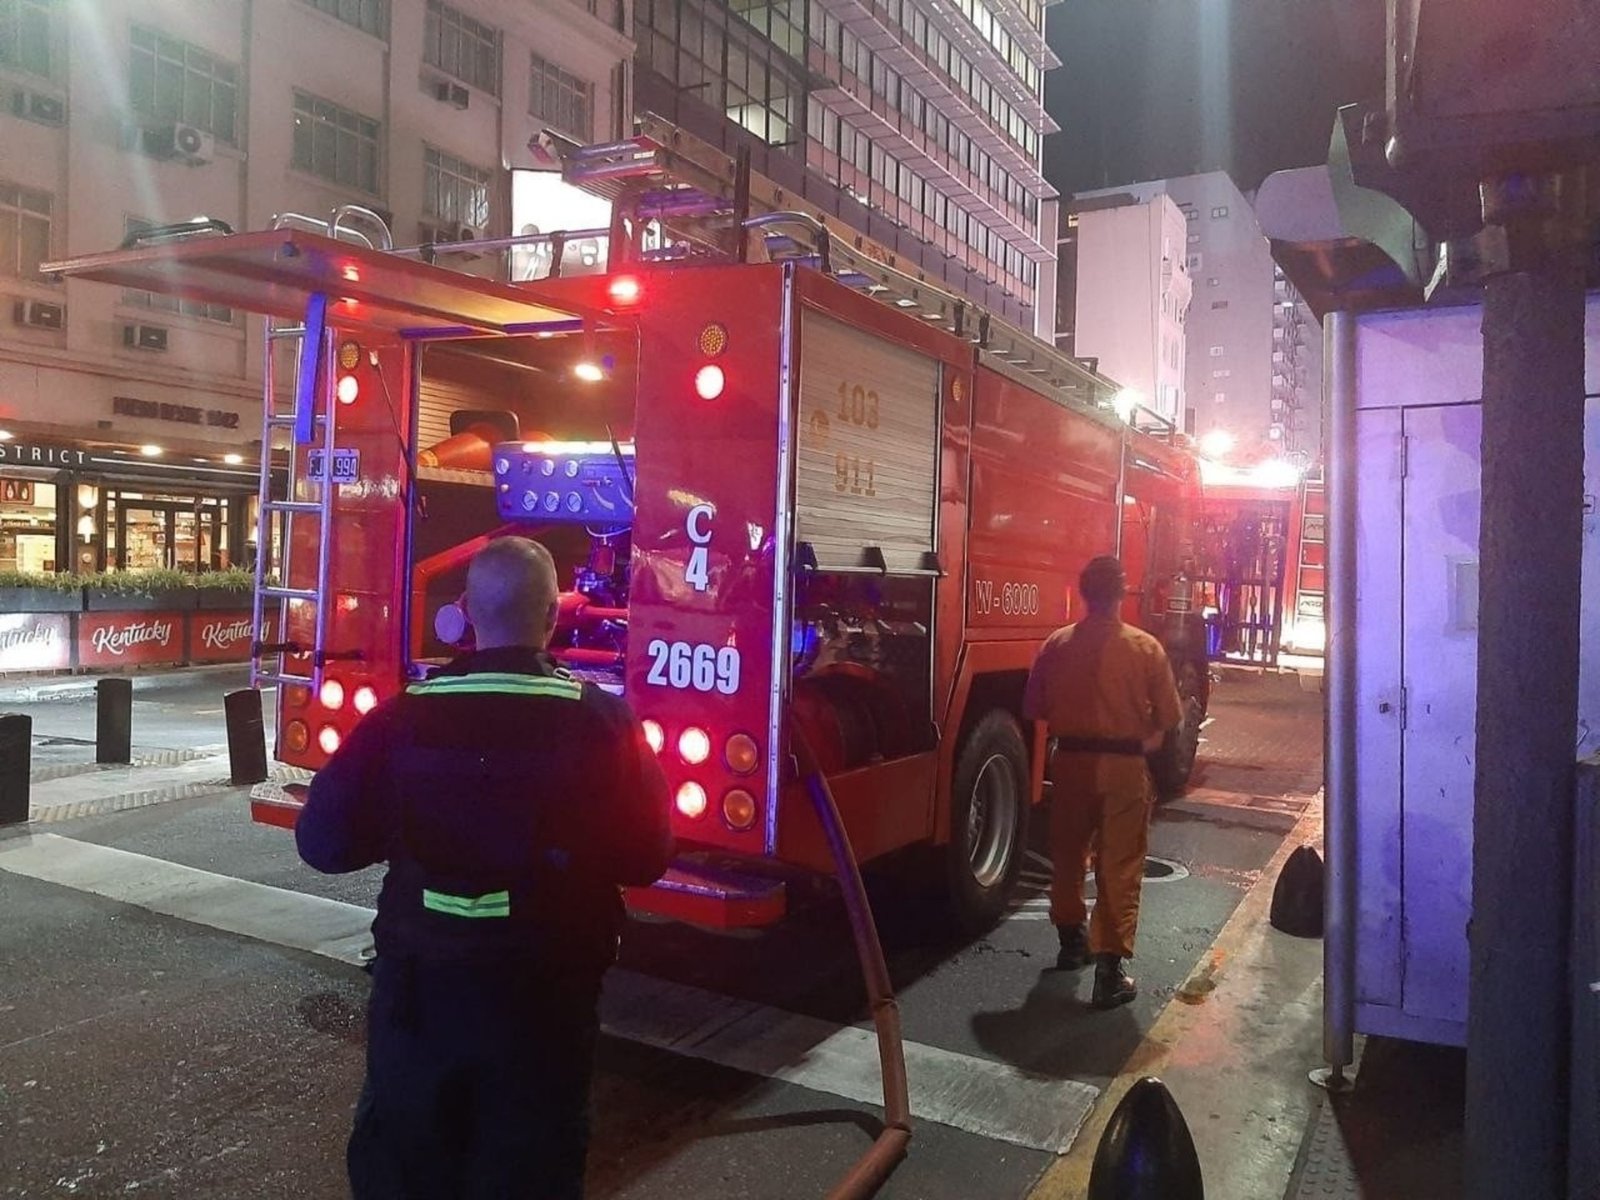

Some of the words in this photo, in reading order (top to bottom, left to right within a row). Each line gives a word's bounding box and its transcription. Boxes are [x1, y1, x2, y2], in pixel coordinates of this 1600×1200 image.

[837, 381, 879, 429] 103
[835, 451, 876, 497] 911
[687, 505, 713, 543] C
[685, 547, 709, 590] 4
[975, 580, 1039, 615] W-6000
[92, 620, 172, 655] Kentucky
[202, 620, 271, 649] Kentucy
[647, 640, 740, 694] 2669
